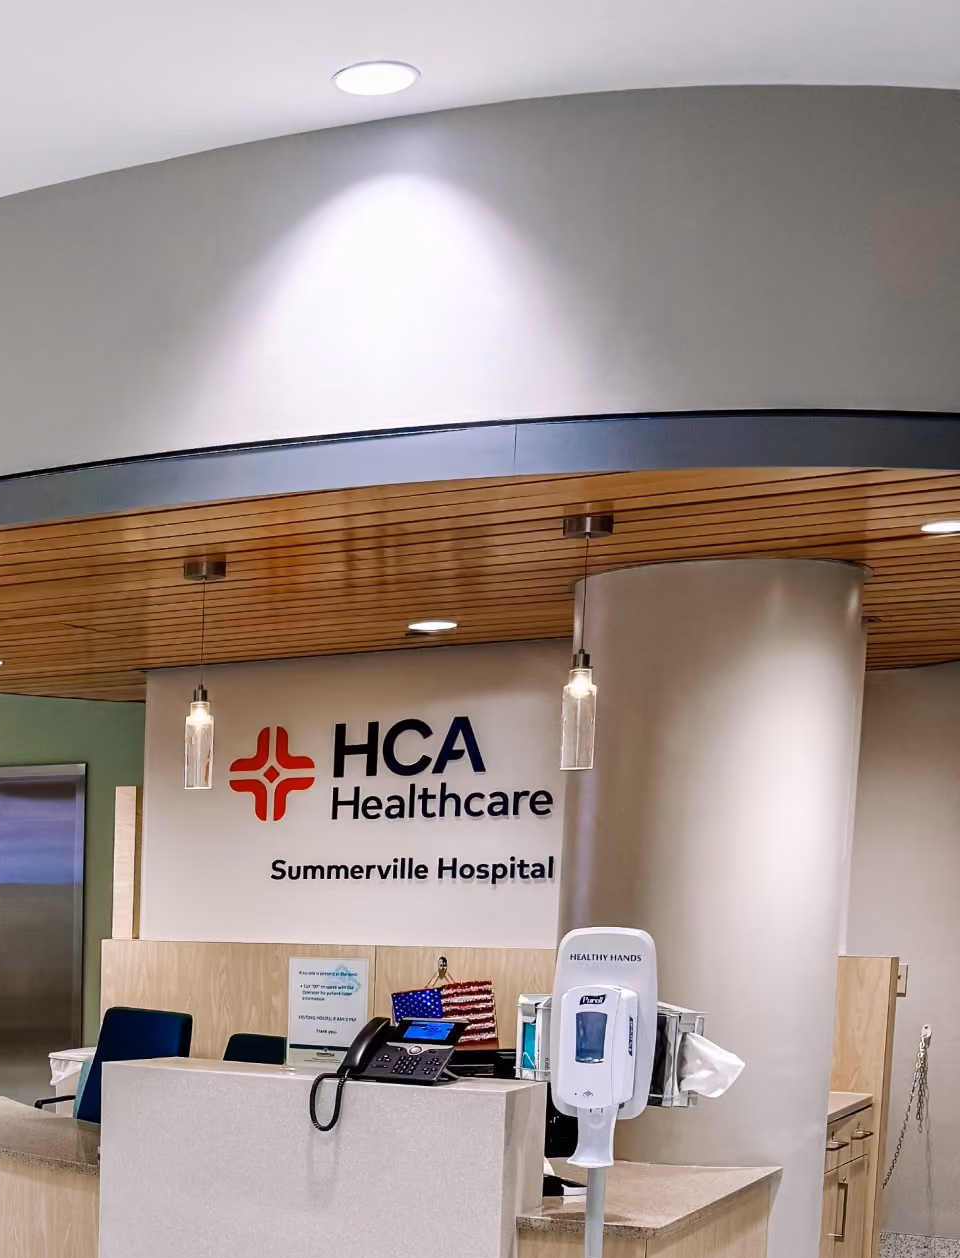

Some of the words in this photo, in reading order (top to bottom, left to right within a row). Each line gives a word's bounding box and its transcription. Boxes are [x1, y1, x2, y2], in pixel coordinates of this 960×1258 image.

[333, 716, 487, 778] HCA
[331, 782, 554, 820] Healthcare
[271, 857, 429, 881] Summerville
[437, 856, 554, 884] Hospital
[570, 953, 608, 962] HEALTHY
[610, 953, 642, 963] HANDS
